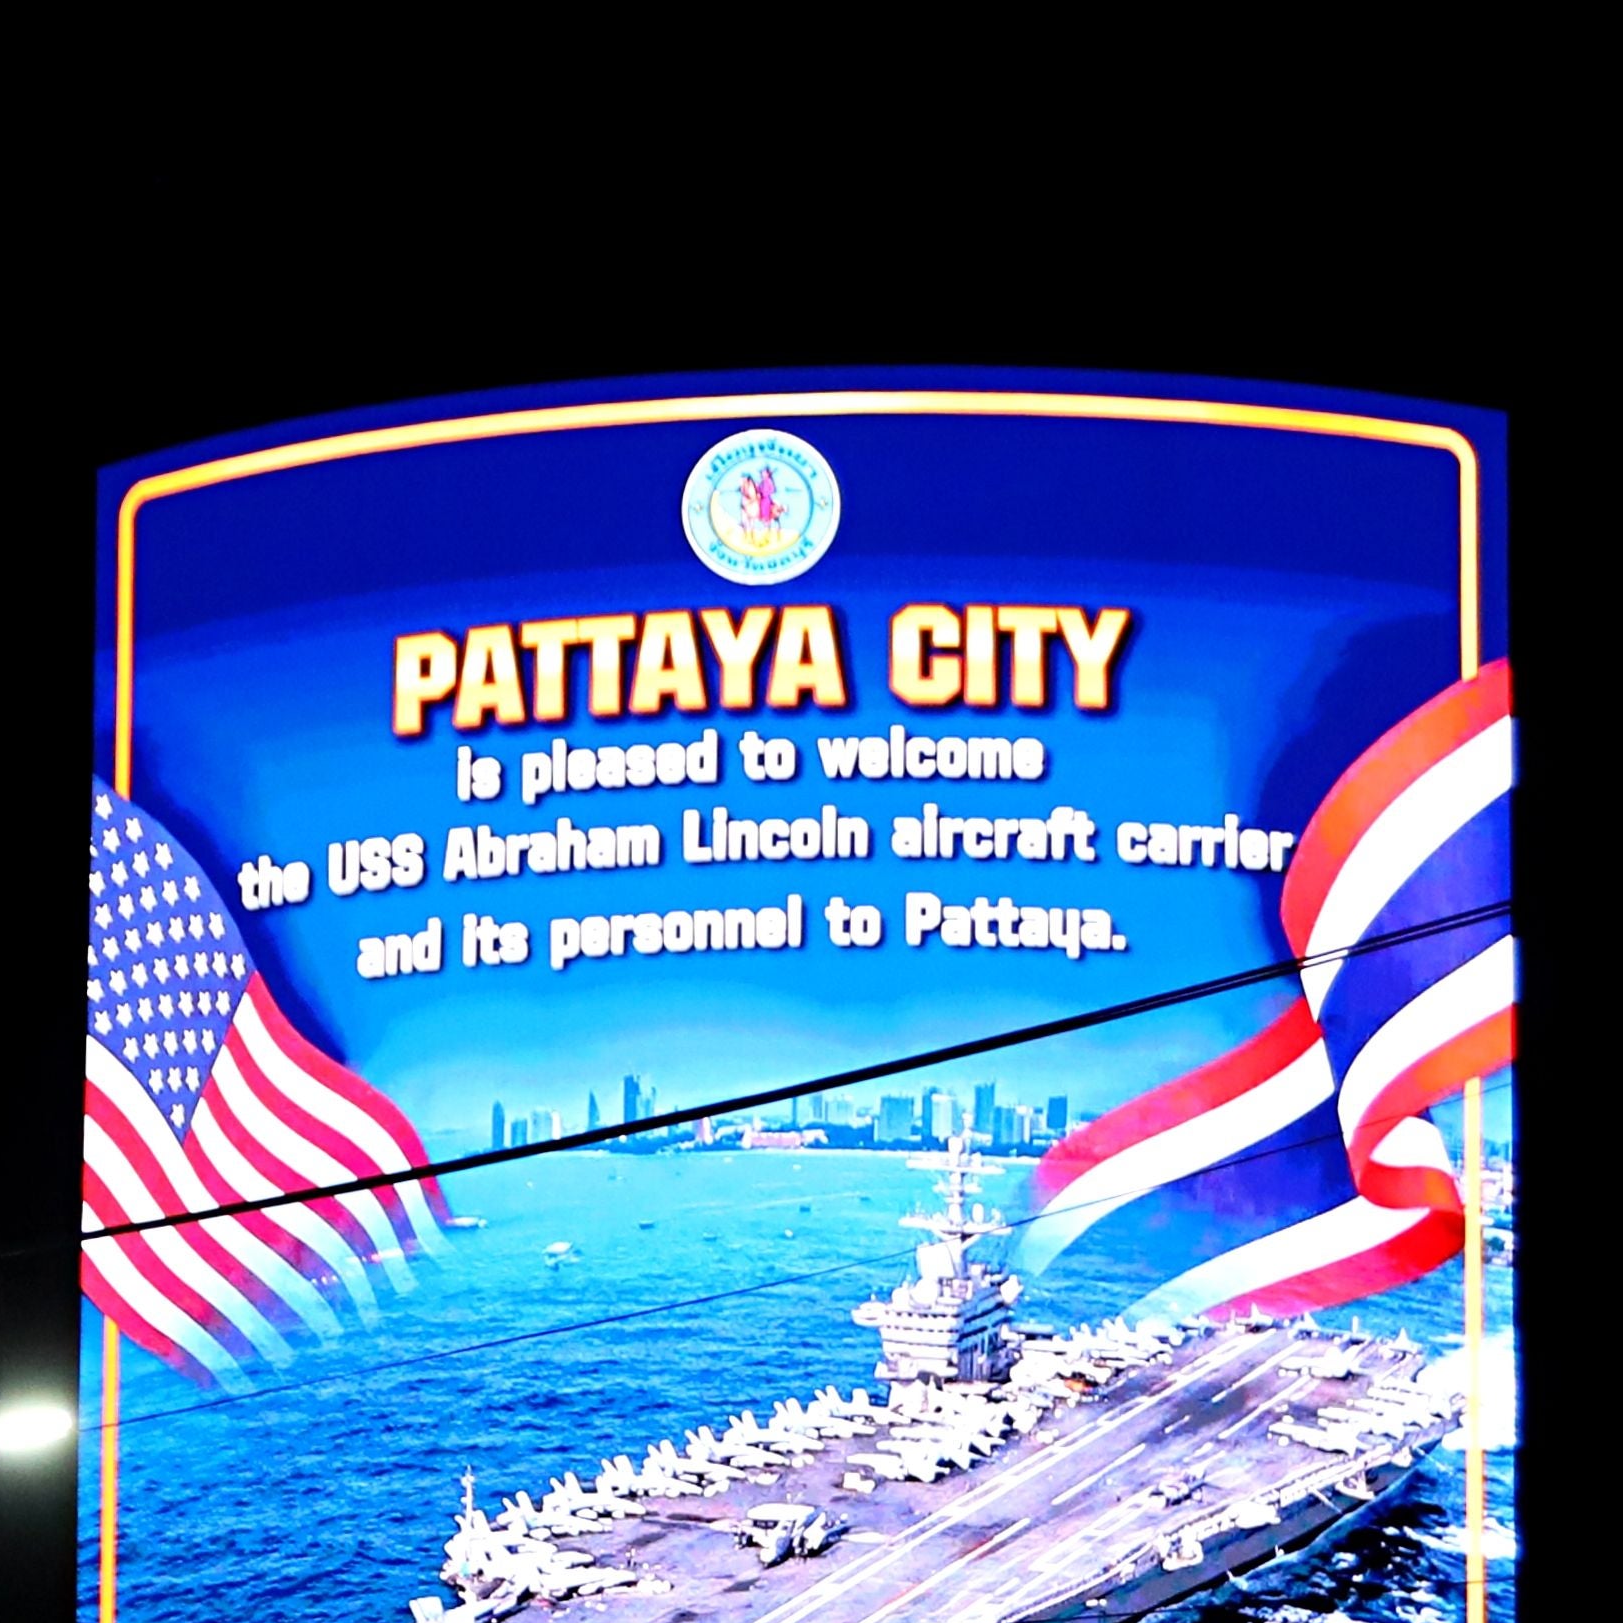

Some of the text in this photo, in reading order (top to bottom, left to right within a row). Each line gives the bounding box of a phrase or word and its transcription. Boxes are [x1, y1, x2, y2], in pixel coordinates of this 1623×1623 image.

[391, 603, 1131, 737] PATTAYA CITY
[457, 724, 1045, 805] is pleased to welcome
[237, 802, 1295, 912] the USS Abraham Lincoln aircraft carrier
[357, 892, 1128, 978] and its personnel to Pattaya.
